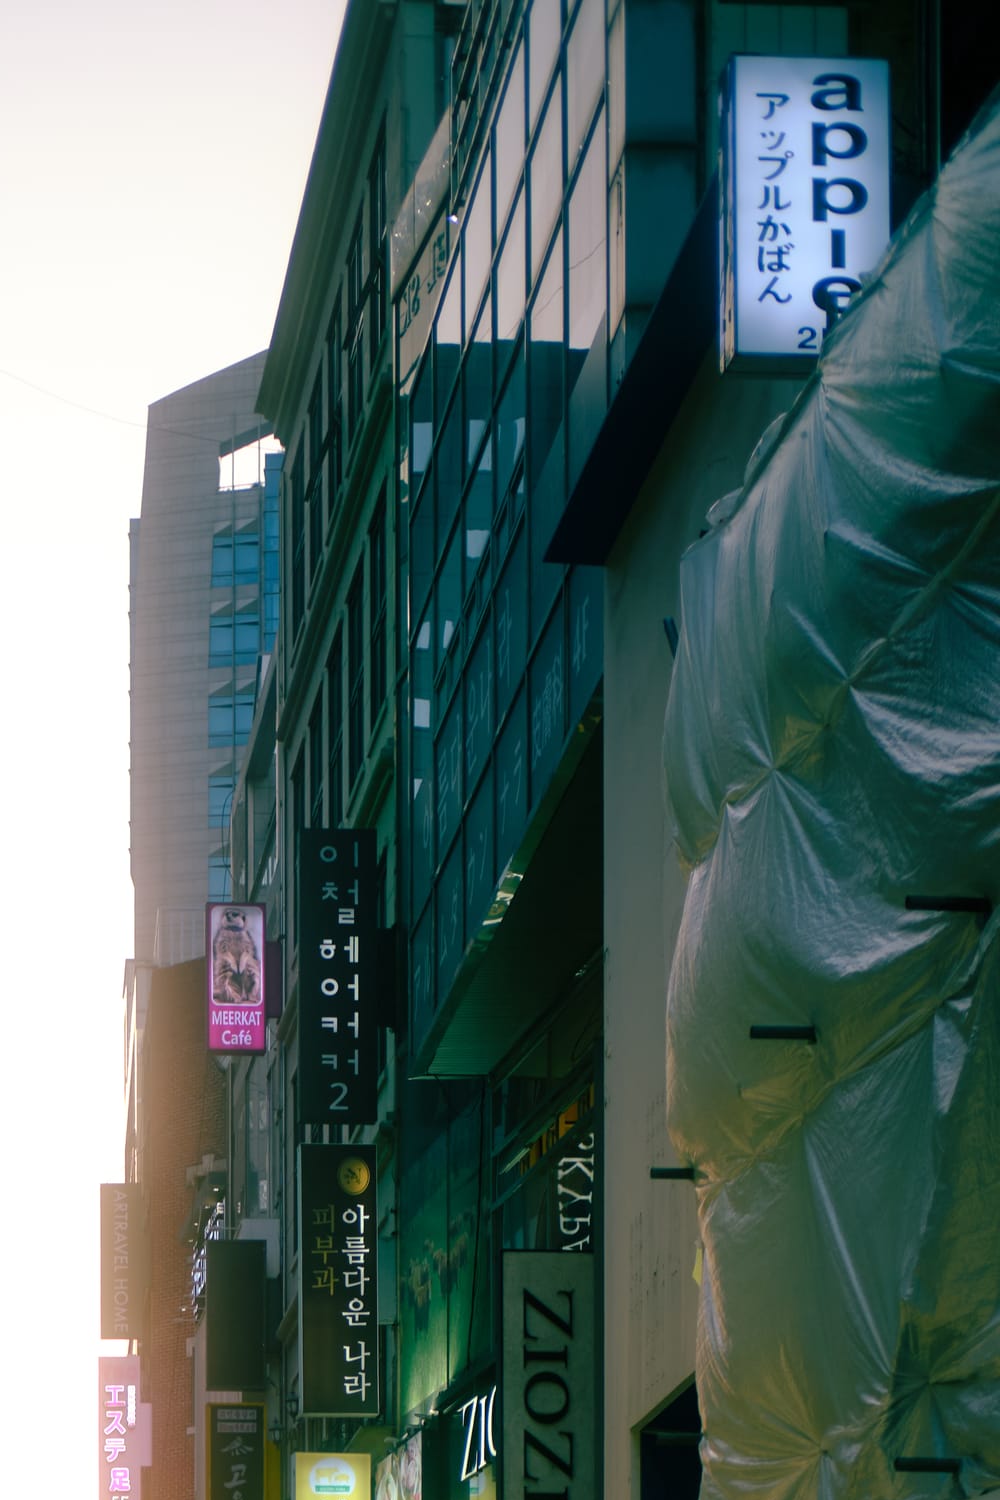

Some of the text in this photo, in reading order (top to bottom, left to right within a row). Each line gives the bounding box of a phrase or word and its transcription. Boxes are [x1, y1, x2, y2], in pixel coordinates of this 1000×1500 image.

[754, 92, 795, 304] アップルかばん
[796, 327, 826, 350] 2
[211, 1010, 262, 1027] MEERKAT
[221, 1028, 252, 1046] Café
[311, 1205, 339, 1297] 피부과
[114, 1279, 128, 1333] HOME
[341, 1204, 372, 1402] 아름다운 나라
